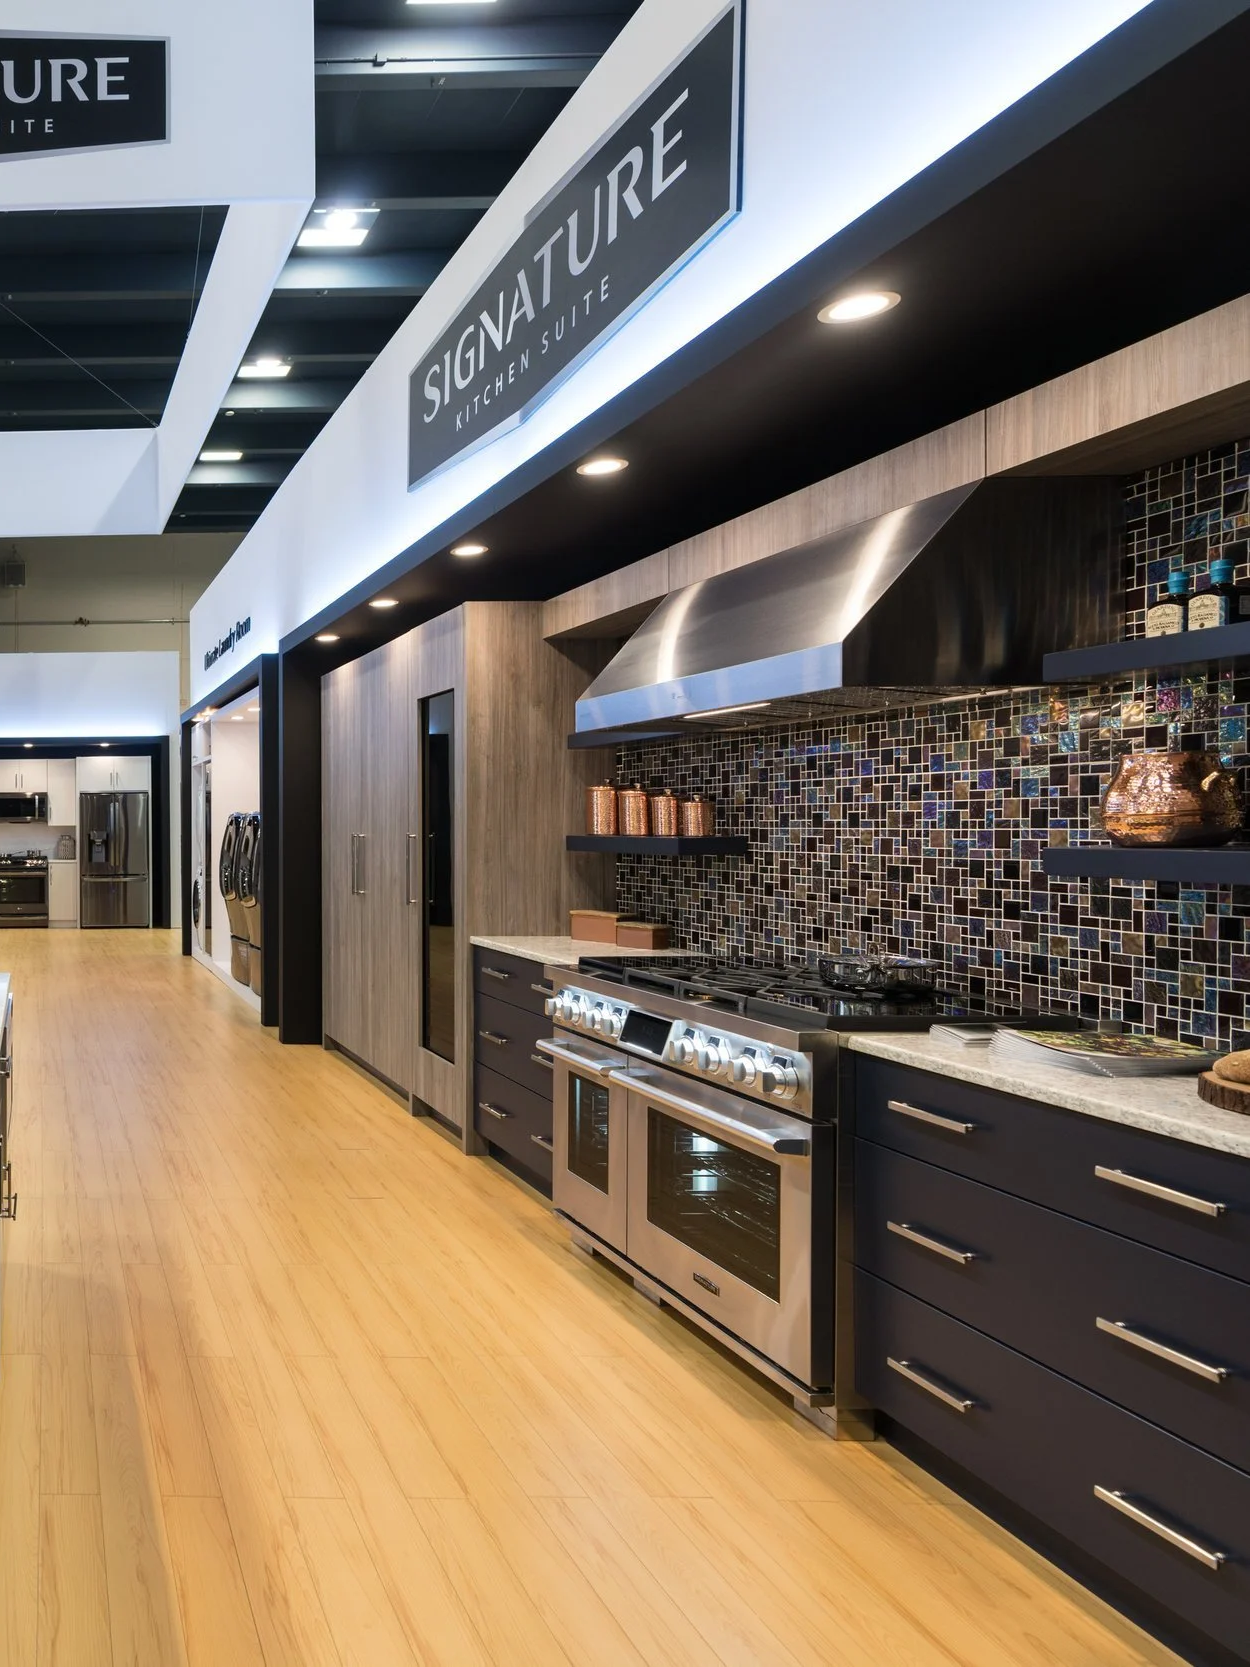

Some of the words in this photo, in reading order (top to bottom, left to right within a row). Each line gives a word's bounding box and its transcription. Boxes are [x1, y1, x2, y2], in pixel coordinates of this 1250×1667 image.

[423, 88, 689, 424] SIGNATURE
[456, 349, 529, 432] KITCHEN
[541, 274, 610, 355] SUITE
